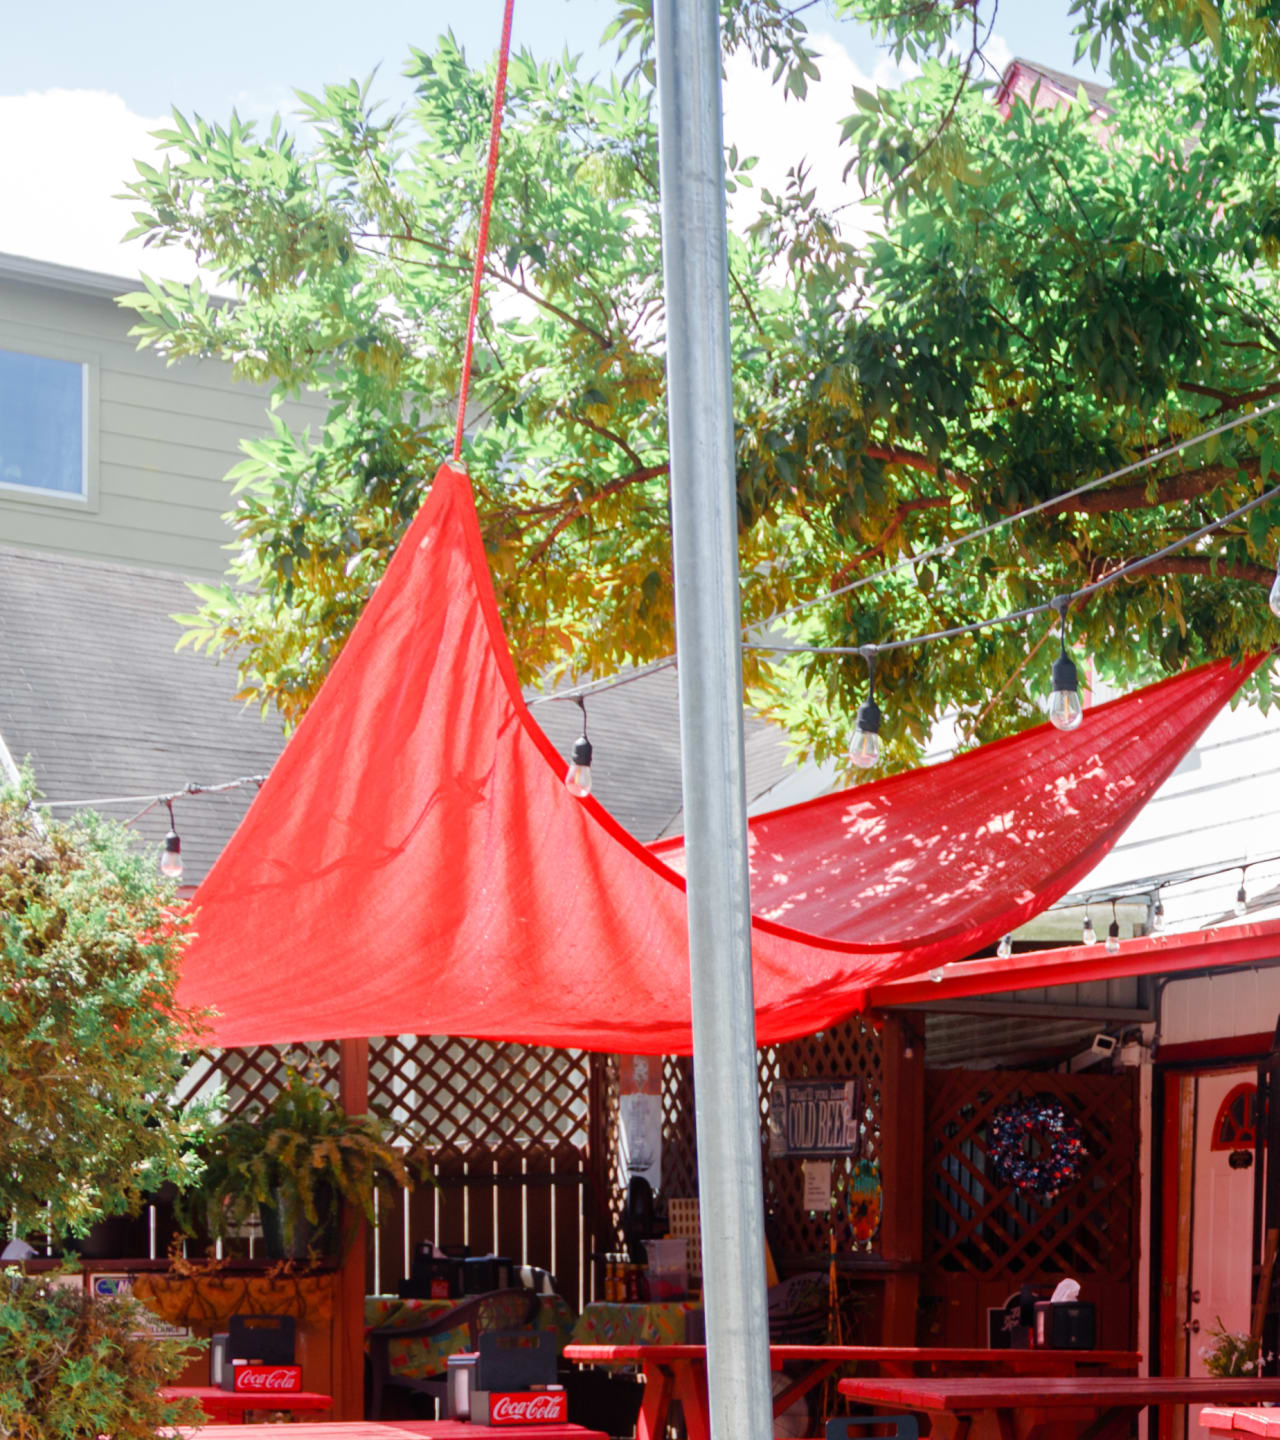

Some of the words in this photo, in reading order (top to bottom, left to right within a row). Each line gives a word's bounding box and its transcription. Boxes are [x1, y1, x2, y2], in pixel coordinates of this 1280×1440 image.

[788, 1101, 816, 1148] COLD
[236, 1368, 298, 1389] Coca-Cola
[492, 1395, 564, 1421] Coca-Cola
